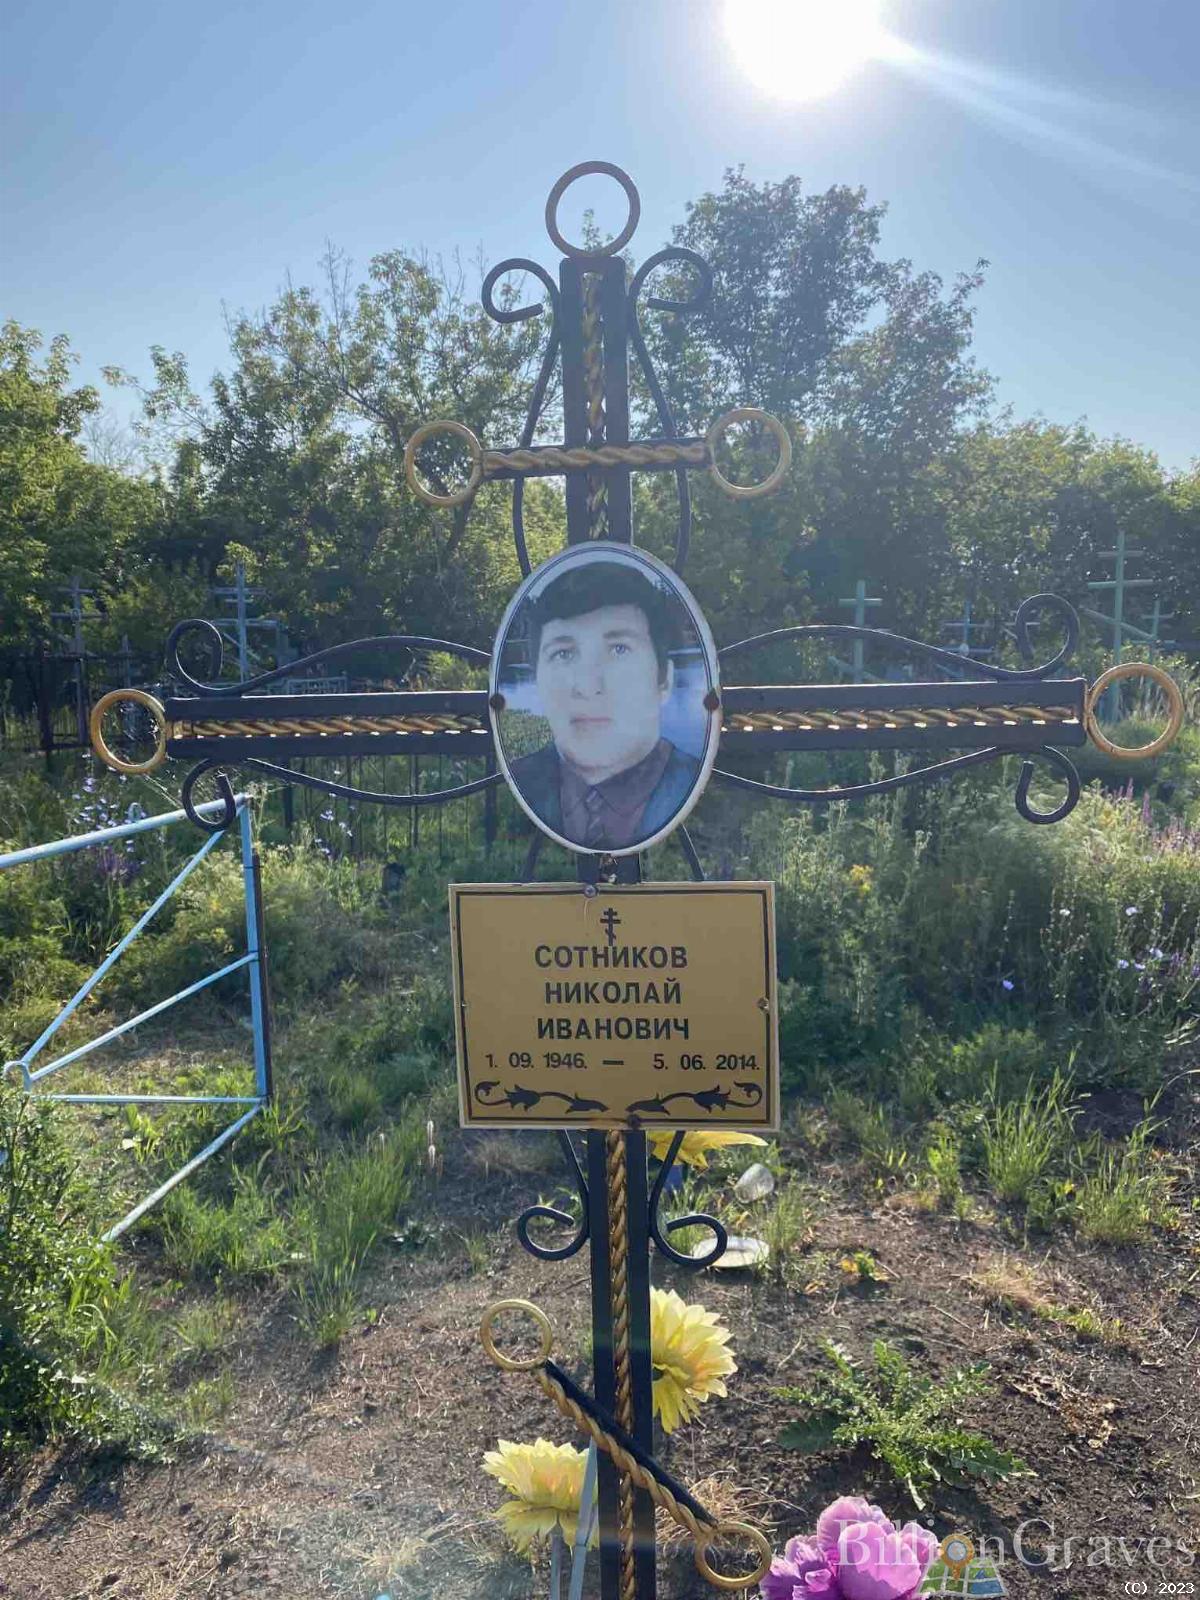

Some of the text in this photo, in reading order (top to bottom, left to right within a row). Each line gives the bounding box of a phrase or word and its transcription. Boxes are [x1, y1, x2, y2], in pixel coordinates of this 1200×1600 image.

[534, 945, 688, 969] СОТНИКОВ
[545, 977, 682, 1005] НИКОЛАЙ
[537, 1017, 690, 1040] ИВАНОВИЧ
[485, 1053, 498, 1068] 1.
[508, 1052, 534, 1069] 09.
[543, 1052, 588, 1069] 1946.
[653, 1053, 668, 1070] 5.
[680, 1053, 706, 1070] 06.
[715, 1054, 760, 1071] 2014.
